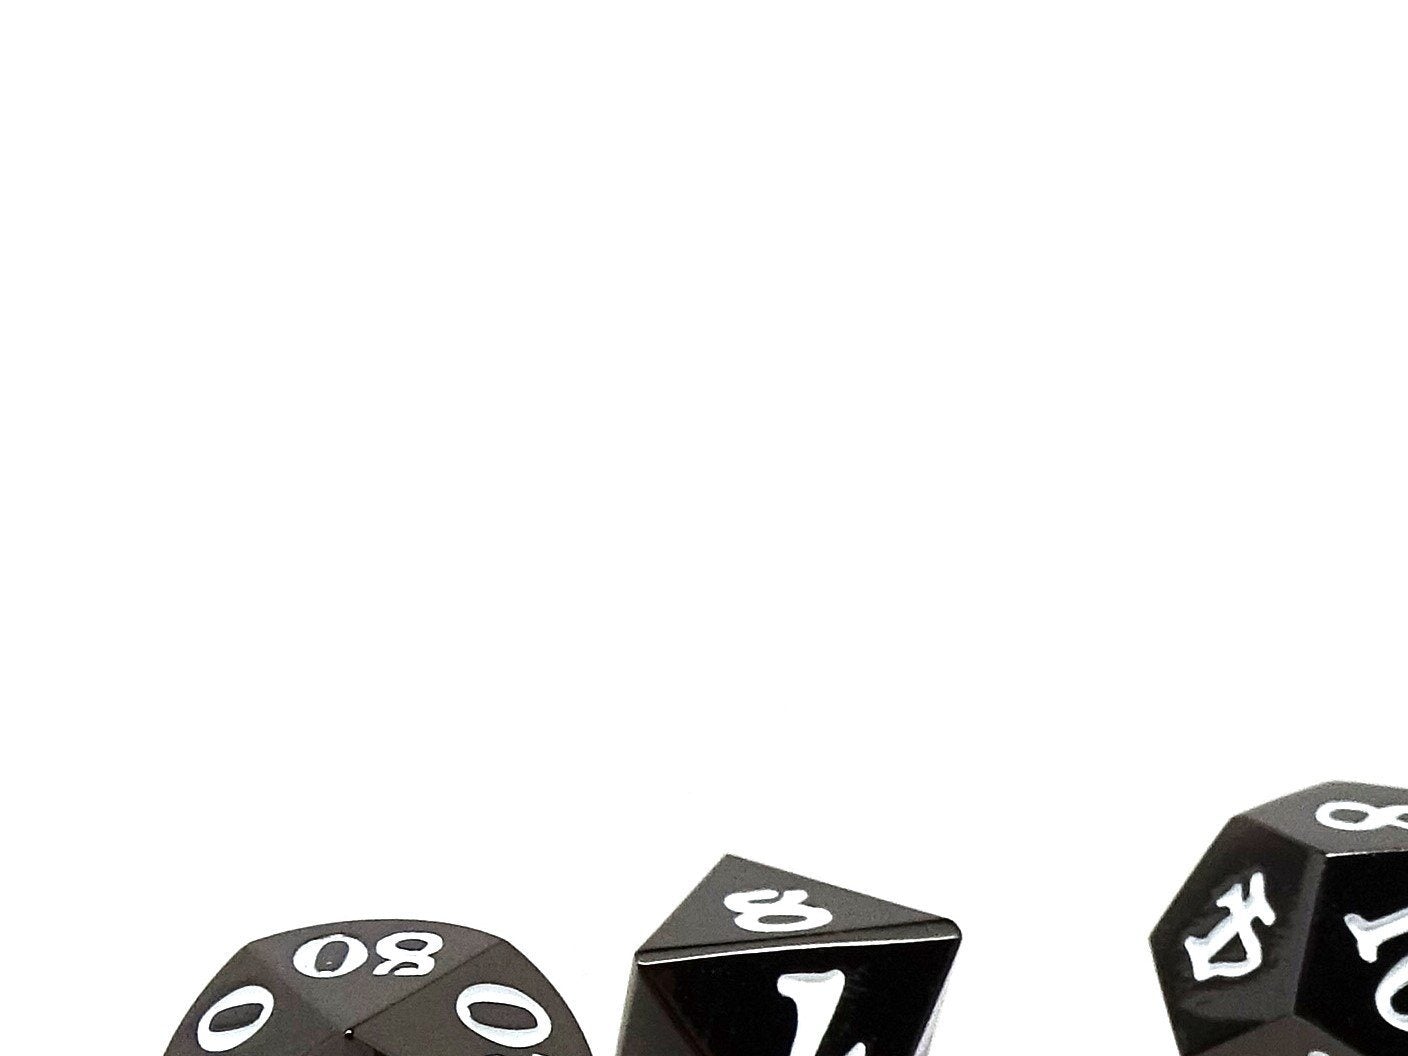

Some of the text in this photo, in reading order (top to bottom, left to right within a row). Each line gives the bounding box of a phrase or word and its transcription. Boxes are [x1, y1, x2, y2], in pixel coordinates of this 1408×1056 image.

[723, 889, 833, 932] 8
[1184, 872, 1276, 981] 4
[293, 931, 443, 977] 80
